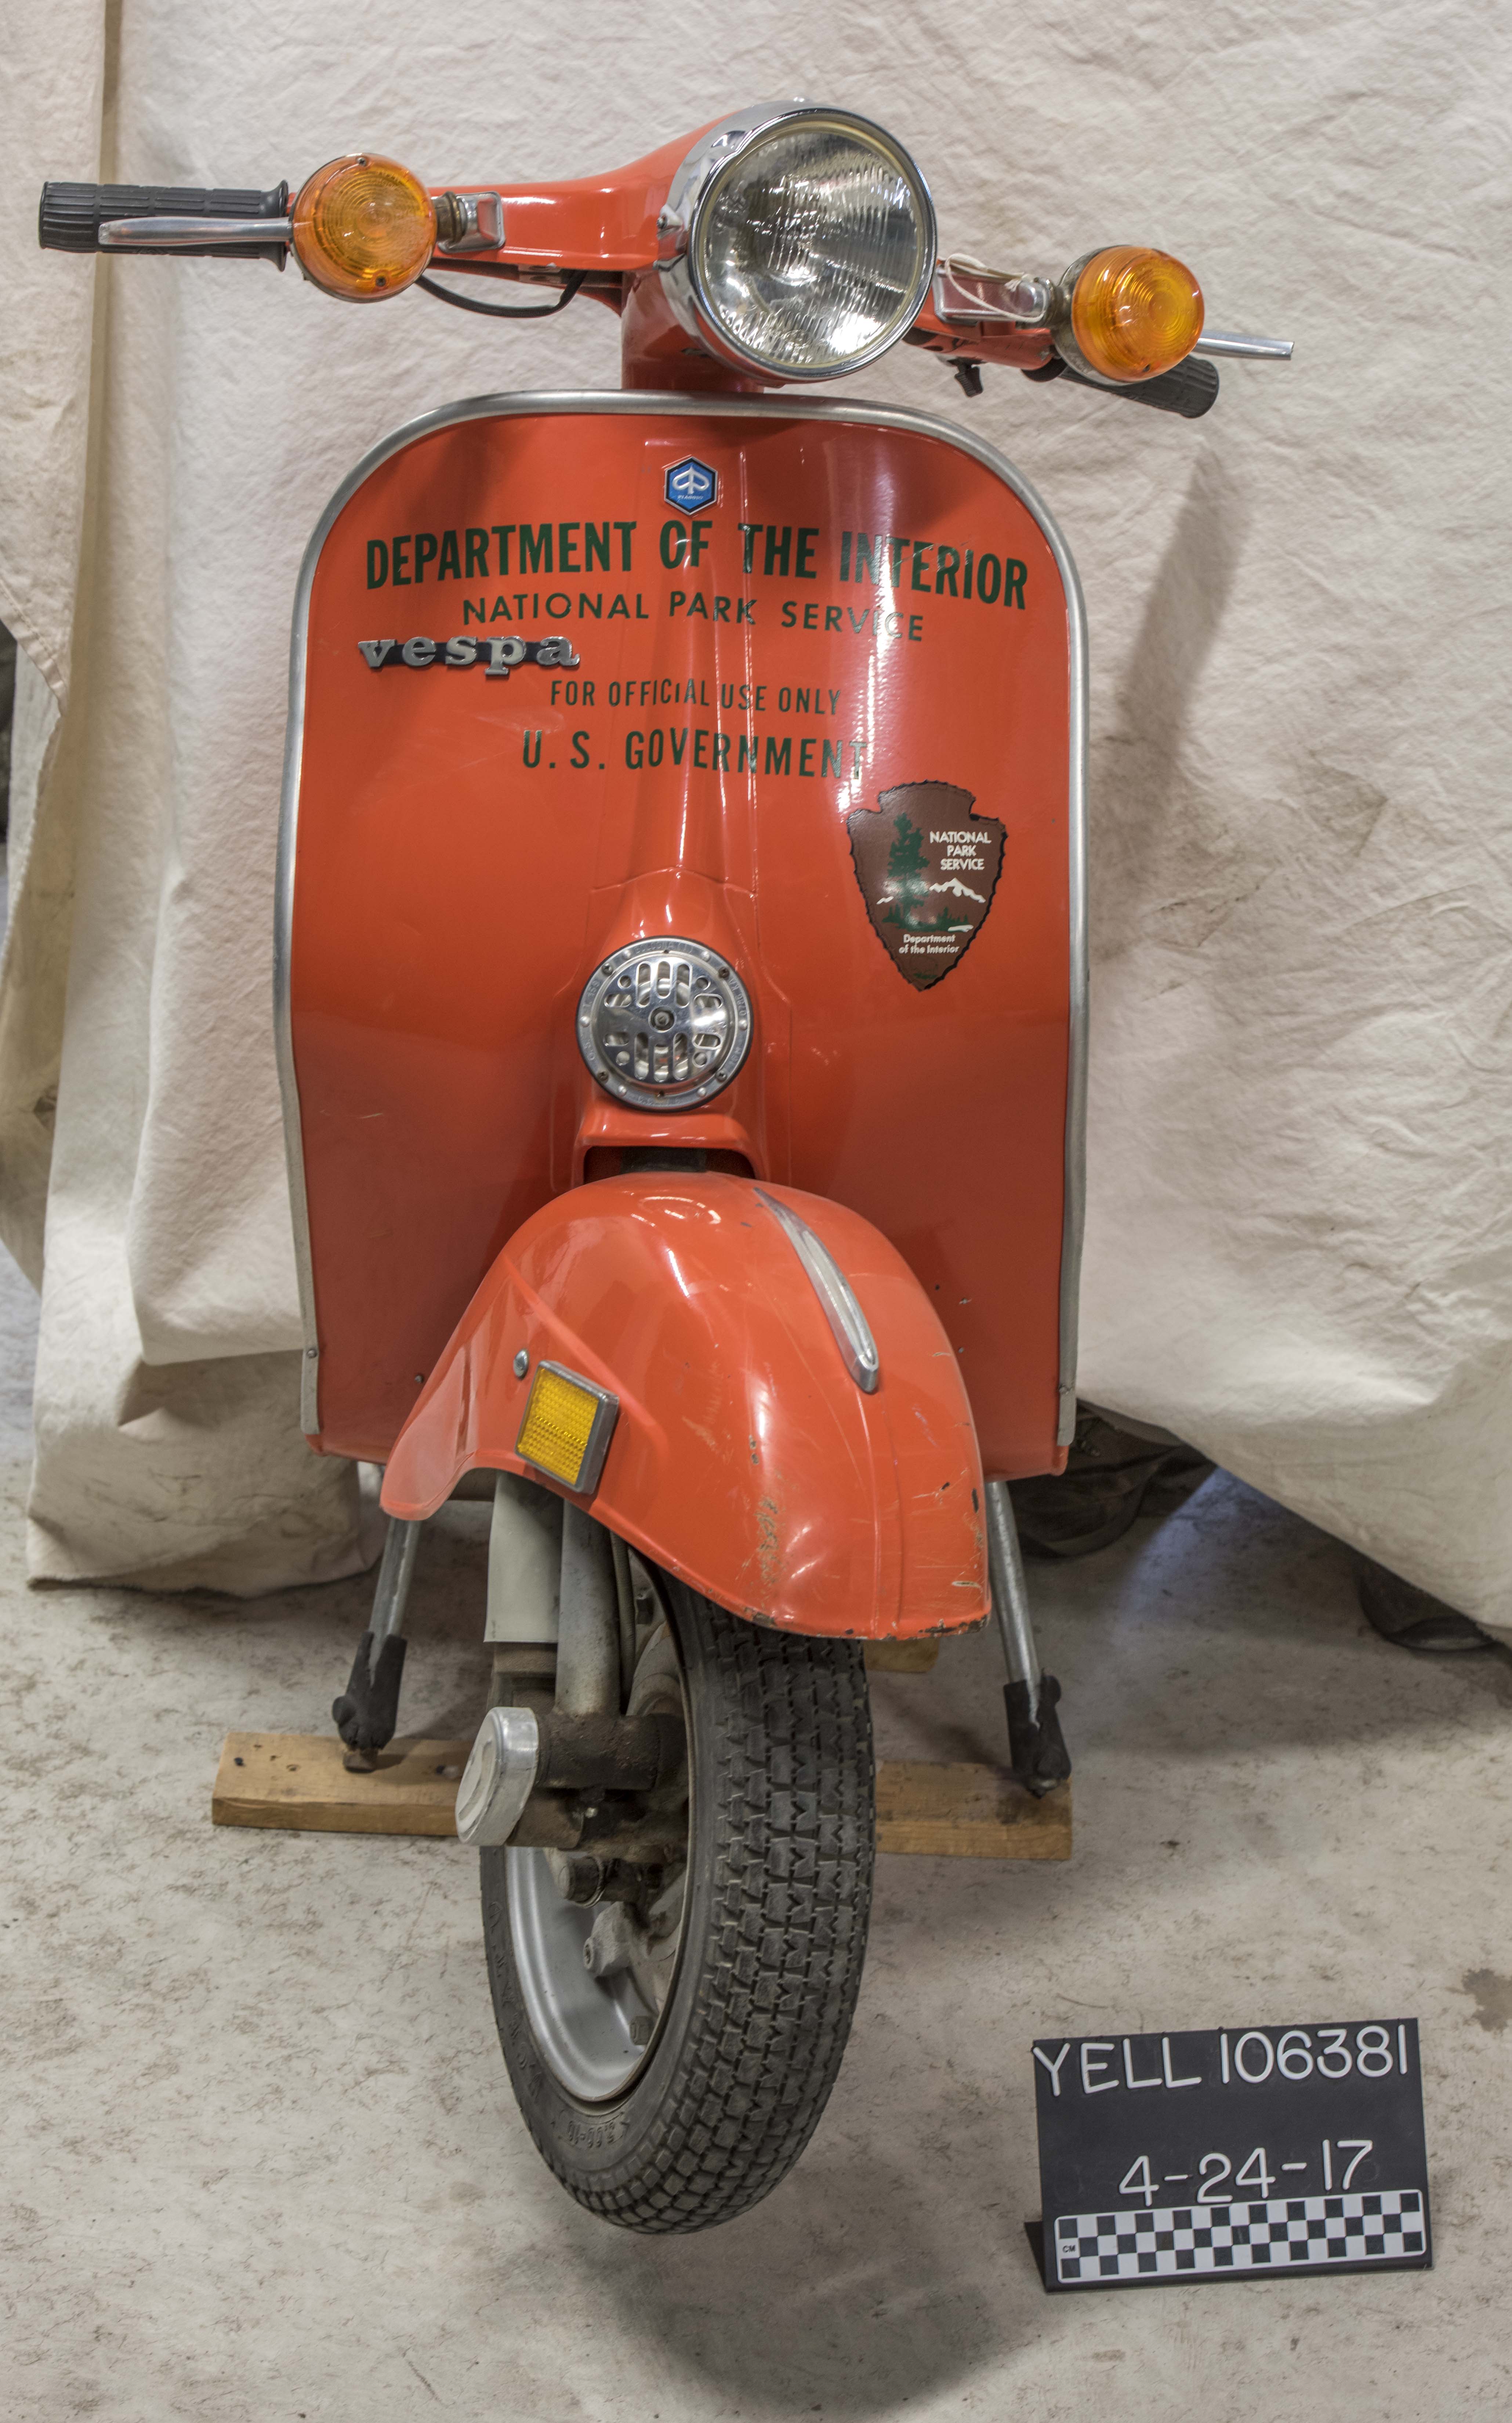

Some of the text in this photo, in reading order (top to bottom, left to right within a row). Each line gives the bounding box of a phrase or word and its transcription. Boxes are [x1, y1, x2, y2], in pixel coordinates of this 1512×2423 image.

[367, 520, 1027, 610] DEPARTMENT OF THE INTERIOR
[463, 591, 923, 641] NATIONAL PARK SERVICE
[358, 636, 580, 676] vespa
[552, 679, 841, 715] FOR OFFICIAL USE ONLY
[523, 728, 867, 779] U. S. GOVERNMENT
[929, 831, 991, 870] NATIONAL PARK SERVICE
[899, 943, 960, 954] of the Interior
[903, 934, 956, 945] Department
[1033, 2024, 1408, 2097] YELL 106381
[1118, 2139, 1373, 2206] 4-24-17
[1062, 2245, 1075, 2253] CM
